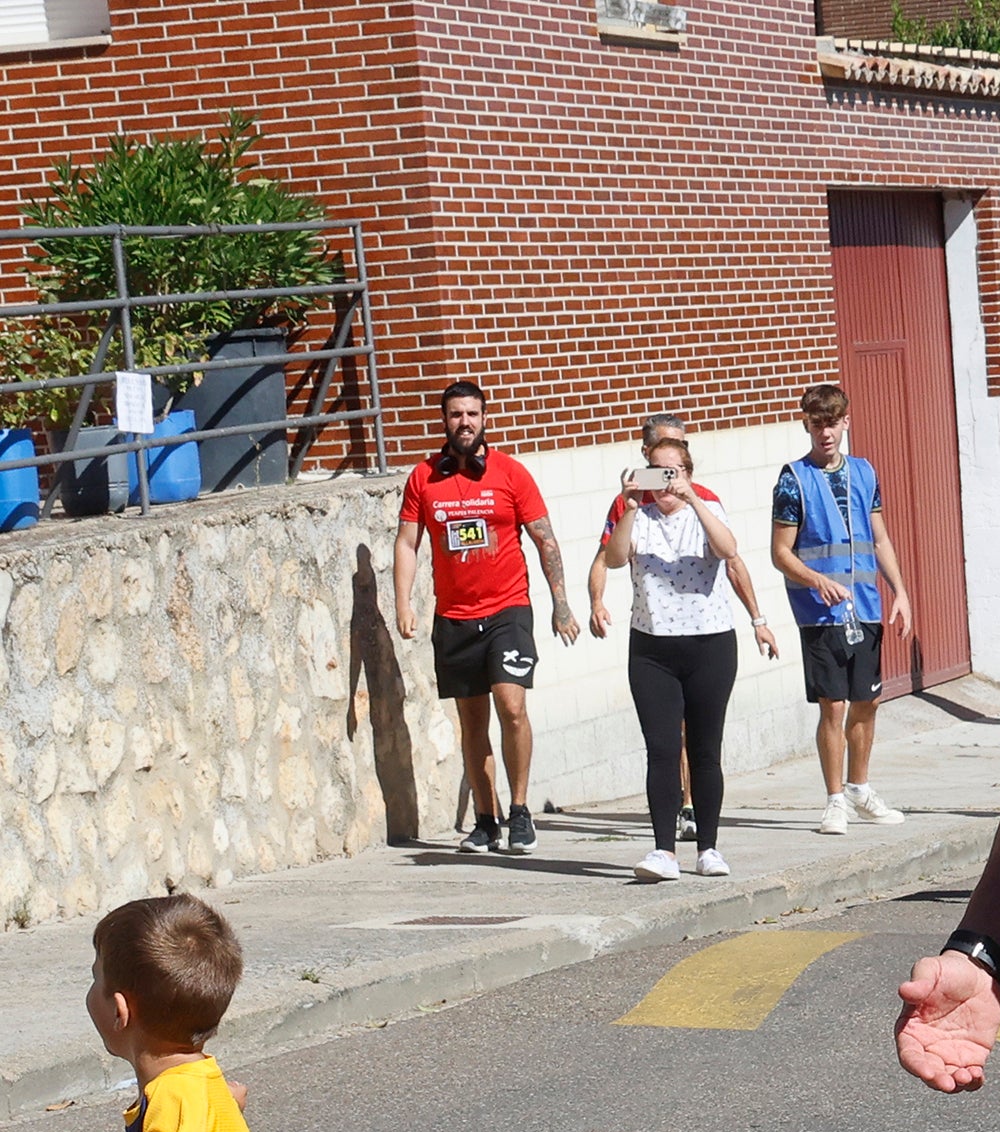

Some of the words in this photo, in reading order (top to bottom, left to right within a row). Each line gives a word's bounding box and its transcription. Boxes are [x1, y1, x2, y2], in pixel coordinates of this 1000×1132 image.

[433, 501, 460, 509] Carrera
[461, 498, 495, 508] solidaria
[459, 527, 483, 541] 541
